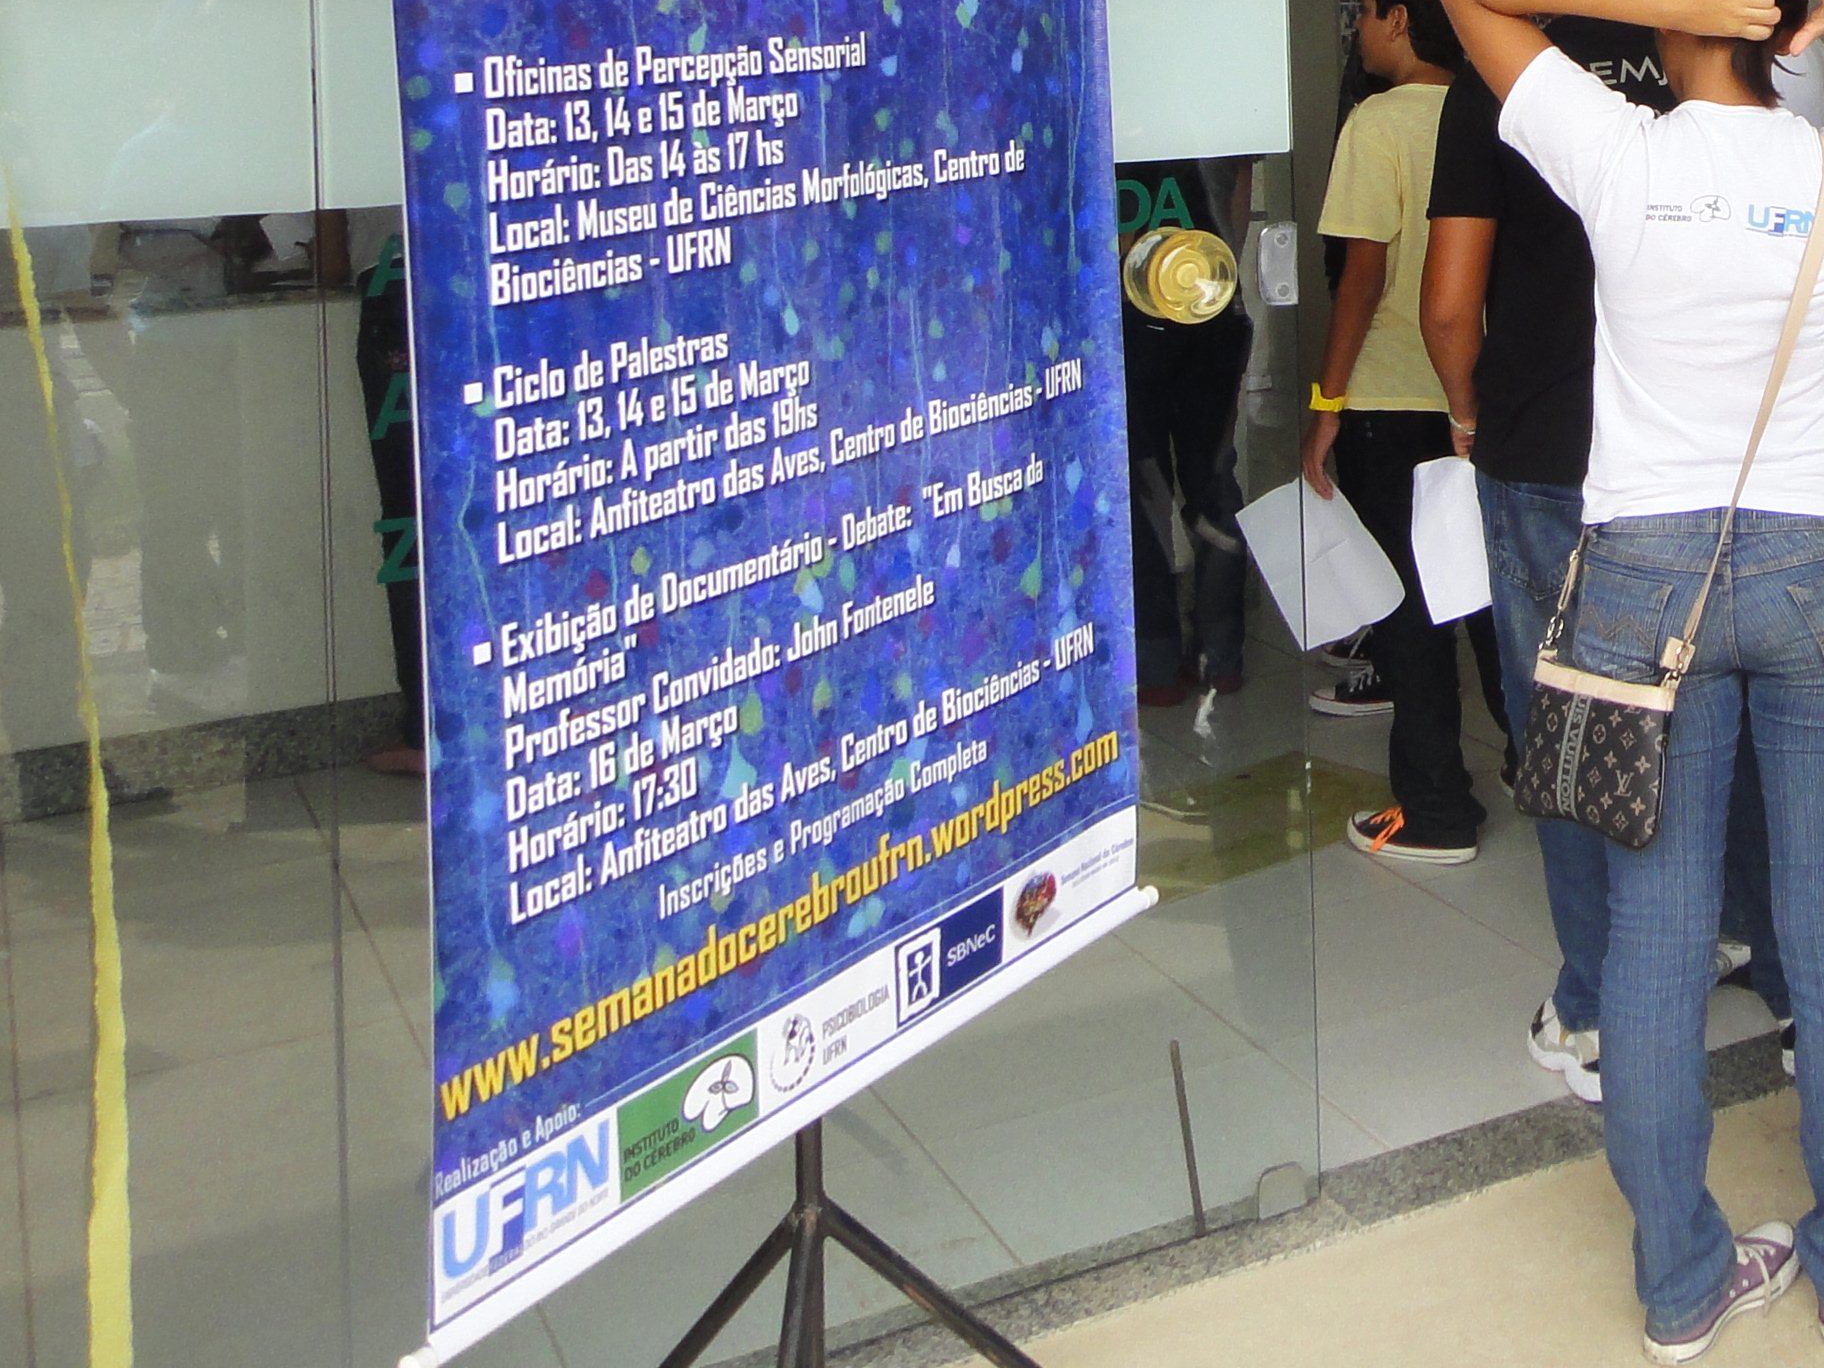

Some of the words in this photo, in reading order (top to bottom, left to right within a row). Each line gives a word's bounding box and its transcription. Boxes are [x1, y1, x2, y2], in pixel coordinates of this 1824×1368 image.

[483, 50, 592, 99] Oficinas
[598, 50, 628, 88] de
[637, 43, 762, 92] Percepção
[769, 32, 866, 75] Sensorial
[487, 106, 557, 150] Data:
[564, 99, 598, 143] 13,
[605, 97, 631, 138] 14
[639, 103, 651, 133] e
[658, 92, 684, 130] 15
[692, 89, 721, 128] de
[728, 89, 798, 130] Março
[488, 151, 601, 203] Horário:
[608, 147, 653, 186] Das
[660, 140, 685, 180] 14
[693, 139, 720, 174] às
[726, 133, 748, 170] 17
[756, 133, 784, 166] hs
[489, 206, 570, 254] Local:
[578, 196, 657, 240] Museu
[663, 188, 694, 226] de
[700, 180, 796, 222] Ciências
[803, 159, 929, 205] Morfológicas,
[933, 145, 1000, 184] Centro
[1000, 139, 1024, 173] de
[490, 250, 642, 306] Biociências
[667, 227, 732, 274] UFRN
[493, 361, 566, 409] Ciclo
[573, 353, 604, 392] de
[611, 332, 729, 384] Palestras
[495, 412, 569, 461] Data:
[577, 400, 611, 443] 13,
[618, 392, 645, 433] 14
[650, 395, 665, 423] e
[672, 378, 697, 419] 15
[703, 371, 733, 411] de
[739, 357, 810, 400] Março
[496, 455, 614, 512] Horário:
[620, 441, 639, 478] A
[645, 423, 718, 483] partir
[725, 408, 766, 453] das
[772, 396, 818, 443] 19hs
[497, 513, 582, 565] Local:
[589, 467, 716, 541] Anfiteatro
[724, 452, 764, 493] das
[770, 440, 826, 488] Aves,
[830, 420, 896, 464] Centro
[900, 406, 923, 443] de
[929, 381, 1032, 434] Biociências
[1045, 357, 1083, 402] UFRN
[500, 602, 617, 669] Exibição
[624, 586, 655, 627] de
[661, 531, 822, 614] Documentário
[843, 503, 913, 554] Debate:
[923, 484, 962, 520] "Em
[967, 467, 1021, 509] Busca
[1026, 451, 1043, 487] da
[503, 635, 639, 719] Memória"
[505, 693, 646, 770] Professor
[652, 642, 781, 710] Convidado:
[786, 616, 837, 661] John
[842, 574, 935, 640] Fontenele
[505, 770, 582, 824] Data:
[587, 745, 616, 788] 16
[622, 730, 653, 771] de
[661, 705, 739, 754] Março
[508, 809, 626, 874] Horário:
[631, 756, 696, 814] 17:30
[510, 871, 593, 925] Local:
[599, 809, 727, 892] Anfiteatro
[734, 784, 774, 826] das
[780, 759, 836, 810] Aves,
[841, 723, 907, 770] Centro
[913, 703, 936, 738] de
[942, 659, 1040, 722] Biociências
[1054, 623, 1094, 673] UFRN
[658, 850, 767, 922] Inscrições
[774, 836, 784, 862] e
[790, 780, 904, 848] Programação
[910, 738, 987, 797] Completa
[440, 731, 1118, 1122] www.semanadocerebroufrn.wordpress.com
[947, 924, 996, 967] SBNeC
[435, 1135, 517, 1199] Realização
[522, 1130, 531, 1146] e
[535, 1104, 581, 1142] Apoio:
[623, 1117, 679, 1164] INSTITUTO
[624, 1163, 641, 1181] DO
[442, 1119, 609, 1278] UFRN
